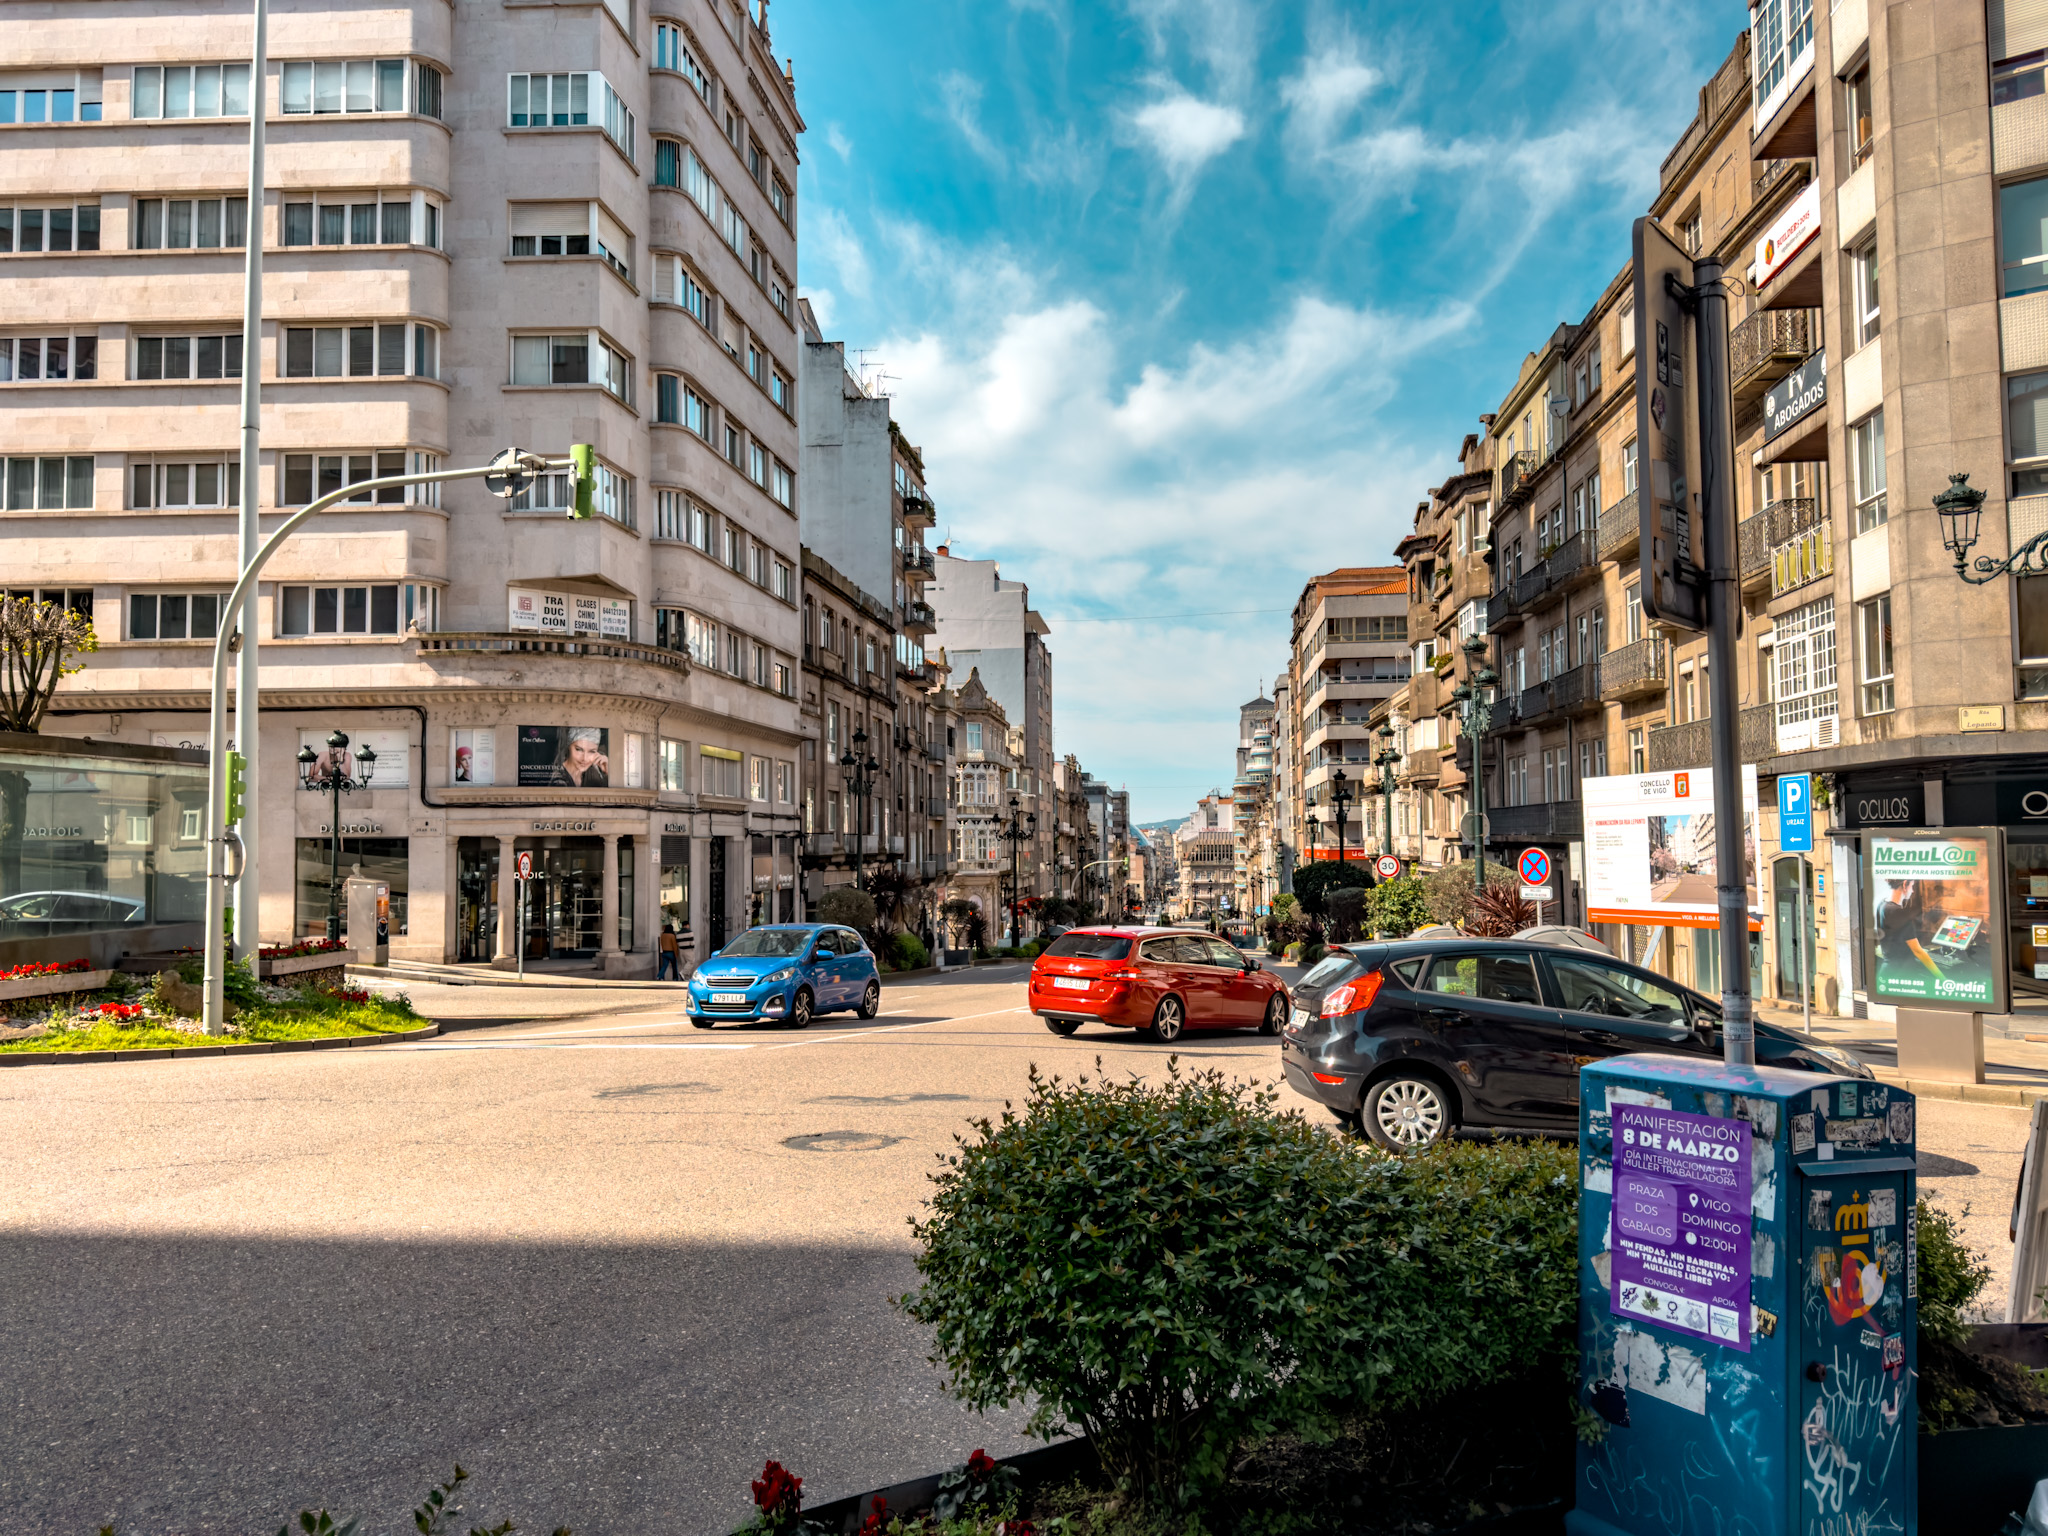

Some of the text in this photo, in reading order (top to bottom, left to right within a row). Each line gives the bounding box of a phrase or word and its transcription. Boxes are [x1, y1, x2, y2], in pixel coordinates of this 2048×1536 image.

[1774, 381, 1824, 430] ABOGADOS
[544, 595, 564, 606] TRA
[576, 599, 597, 609] CLASES
[544, 606, 564, 617] DUC
[578, 609, 595, 620] CHINO
[542, 616, 566, 627] CIÓN
[574, 619, 598, 631] ESPAÑOL
[1640, 779, 1670, 788] CONCELLO
[1786, 782, 1801, 811] P
[1858, 797, 1909, 820] OCULOS
[533, 822, 598, 832] PARFOIS
[1875, 846, 1976, 865] MenuL@n
[521, 862, 529, 870] 30
[1381, 862, 1394, 870] 30
[1930, 868, 1973, 876] HOSTELERÍA
[1935, 979, 1986, 993] L@ndín
[1622, 1112, 1740, 1143] MANIFESTACIÓN
[1623, 1128, 1739, 1163] 8 DE MARZO
[1625, 1149, 1735, 1177] DÍA INTERNACIONAL DA
[1623, 1158, 1738, 1187] MULLER TRABALLADORA
[1629, 1182, 1665, 1199] PRAZA
[1635, 1202, 1658, 1217] DOS
[1701, 1197, 1731, 1213] VIGO
[1621, 1218, 1672, 1238] CABALOS
[1682, 1212, 1741, 1235] DOMINGO
[1620, 1239, 1634, 1249] NIN
[1670, 1251, 1686, 1262] NIN
[1699, 1235, 1737, 1254] 12:00H
[1626, 1249, 1640, 1259] NIN
[1642, 1252, 1684, 1270] TRABALLO
[1642, 1262, 1713, 1286] MULLERES LIBRES
[1712, 1296, 1738, 1308] APOIA:
